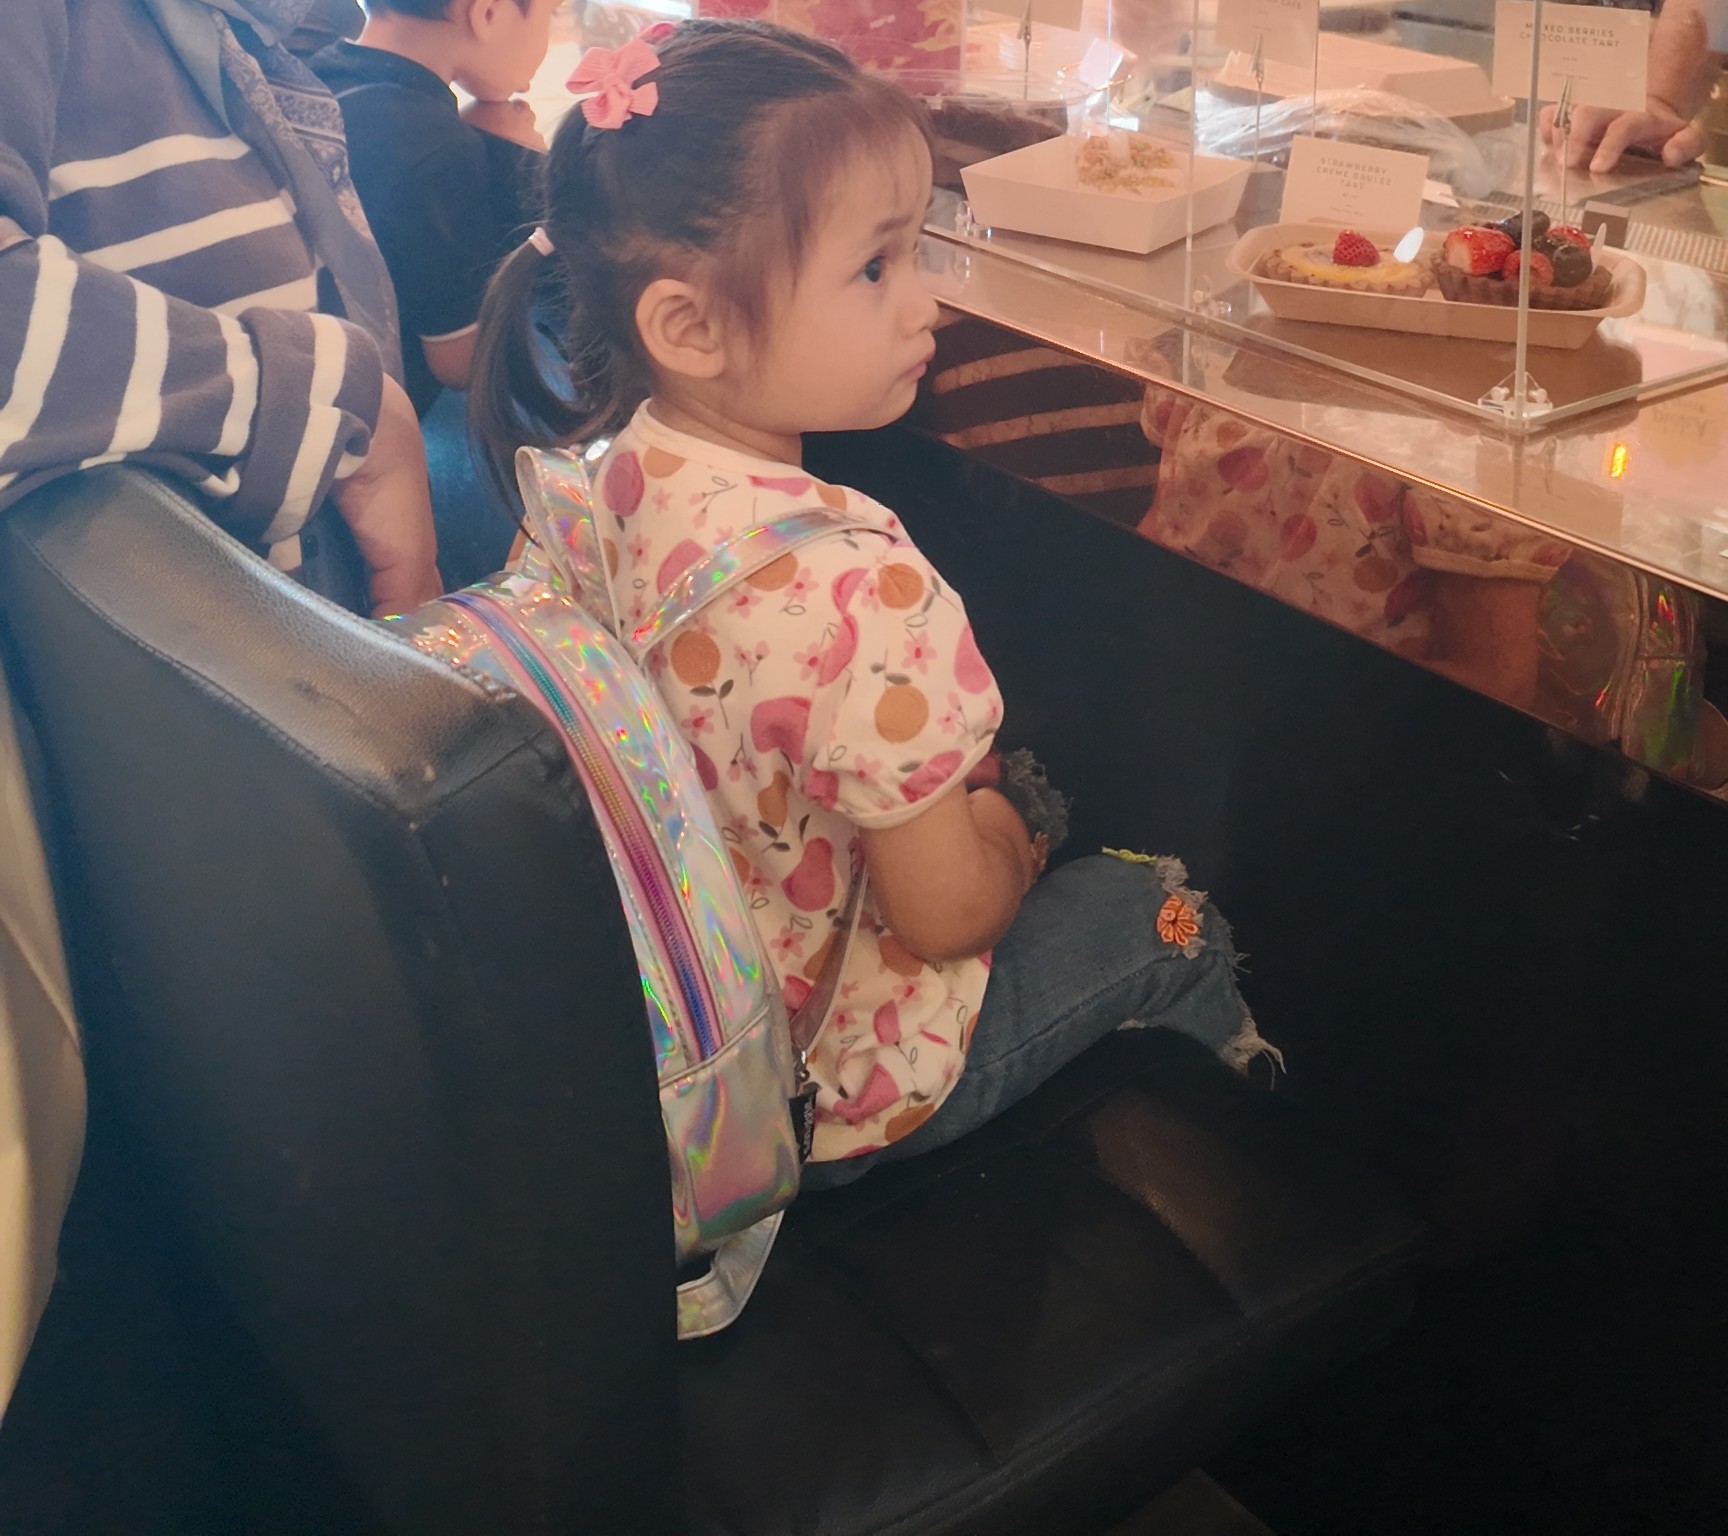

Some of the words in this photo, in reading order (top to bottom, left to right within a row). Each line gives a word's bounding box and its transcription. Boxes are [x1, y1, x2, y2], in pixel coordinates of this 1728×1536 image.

[1525, 23, 1564, 33] MXED
[1568, 26, 1615, 38] BERRIES
[1593, 38, 1620, 48] TART
[1321, 156, 1387, 175] STRAWBERRY
[1340, 179, 1364, 190] TART
